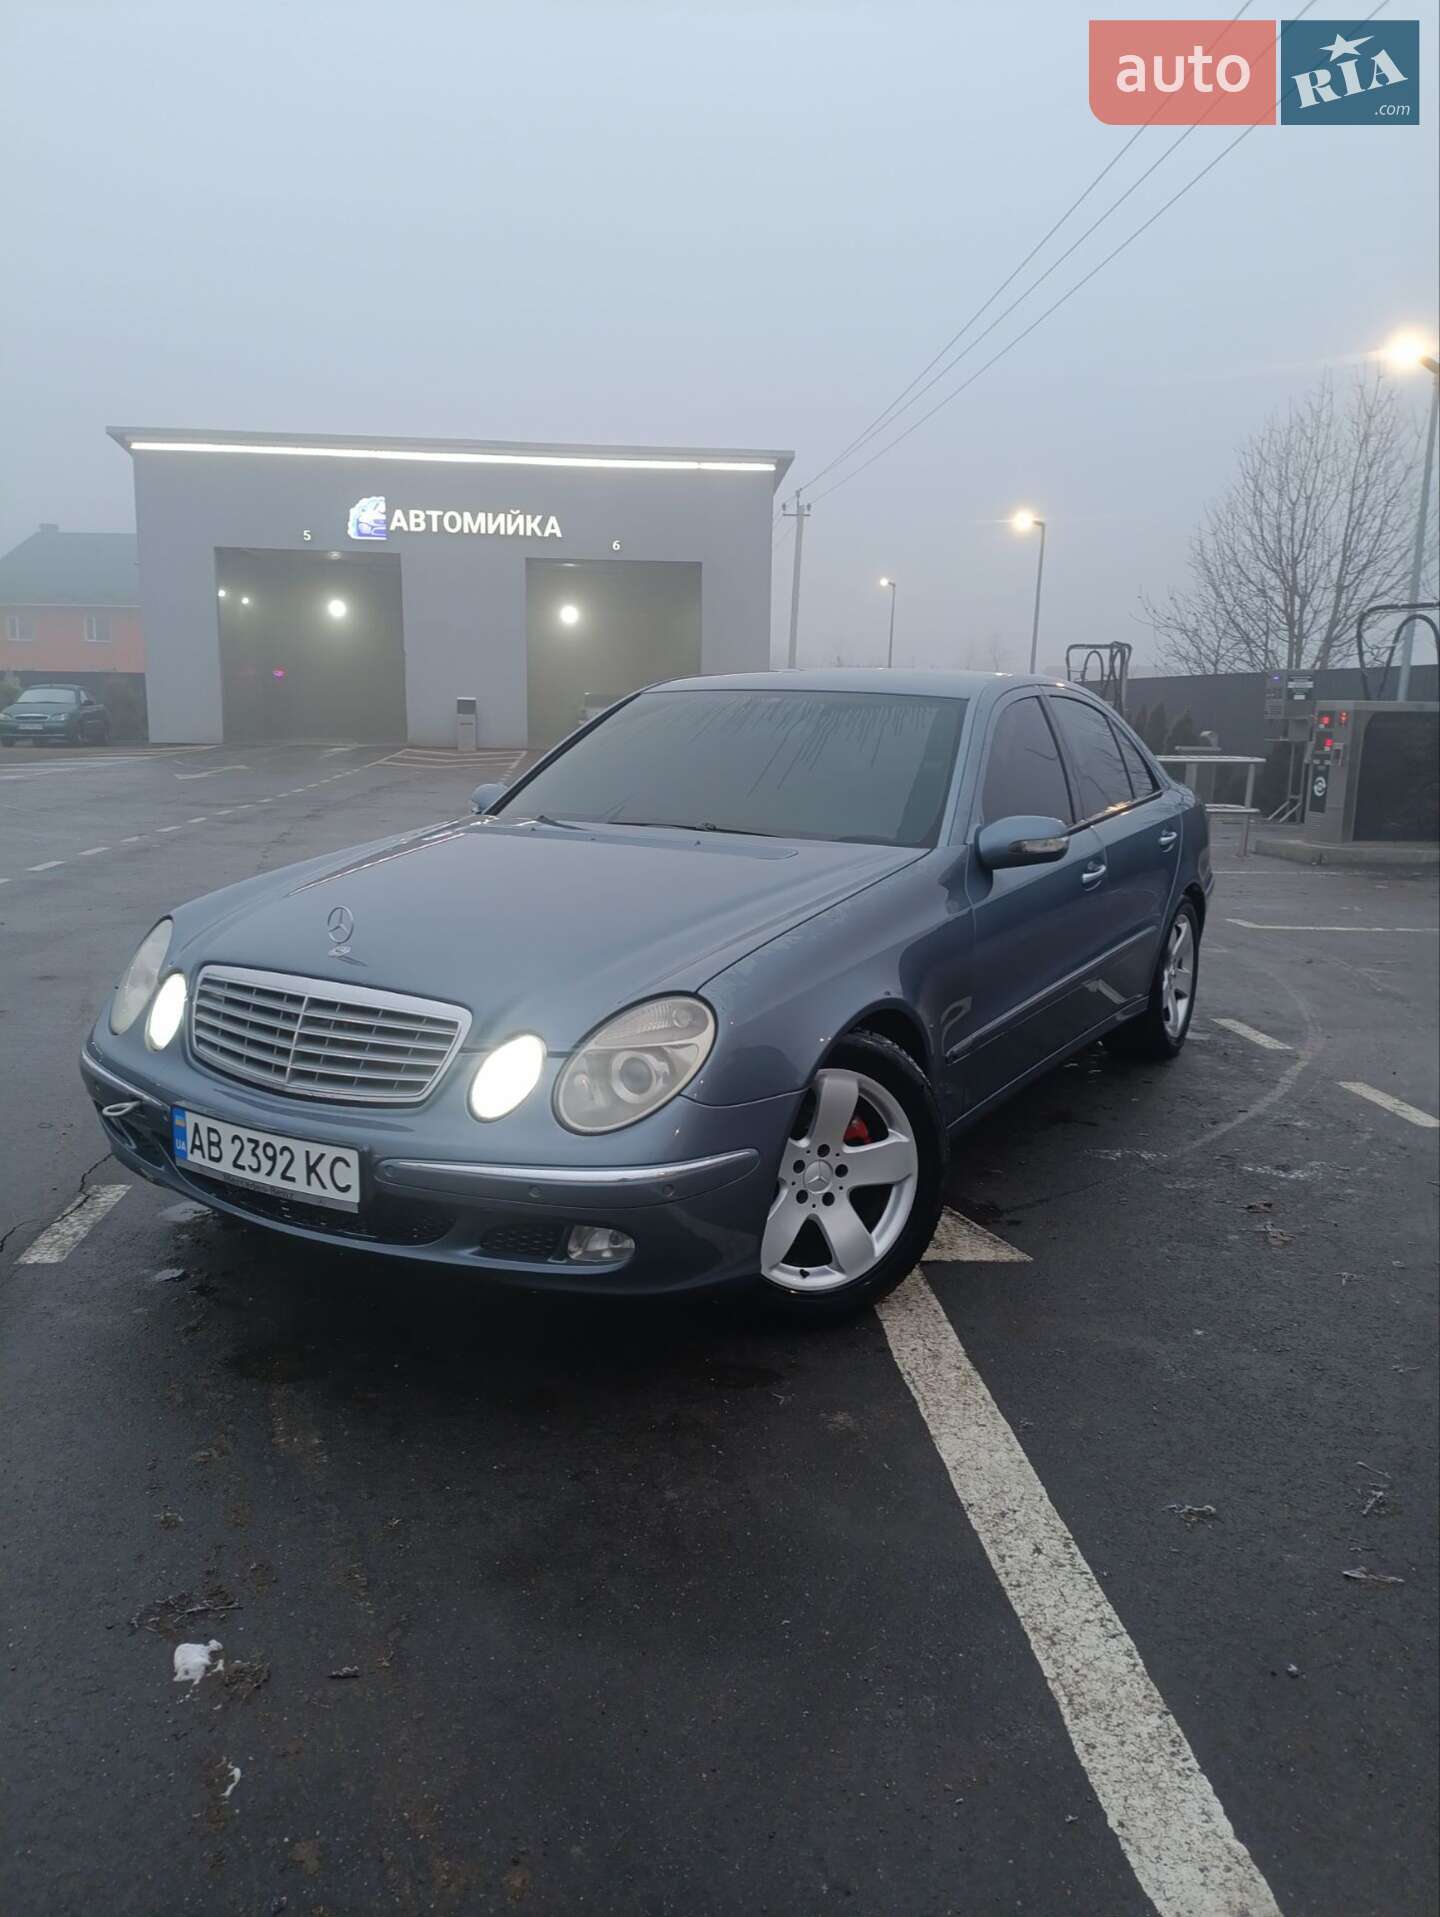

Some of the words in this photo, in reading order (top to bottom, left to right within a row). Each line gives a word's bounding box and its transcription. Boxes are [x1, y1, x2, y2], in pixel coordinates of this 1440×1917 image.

[389, 508, 562, 538] АВТОМИЙКА
[303, 530, 311, 541] 5
[611, 540, 620, 551] 6
[176, 1139, 187, 1152] UA
[190, 1122, 223, 1163] AB
[231, 1134, 296, 1183] 2392
[305, 1150, 351, 1193] KC
